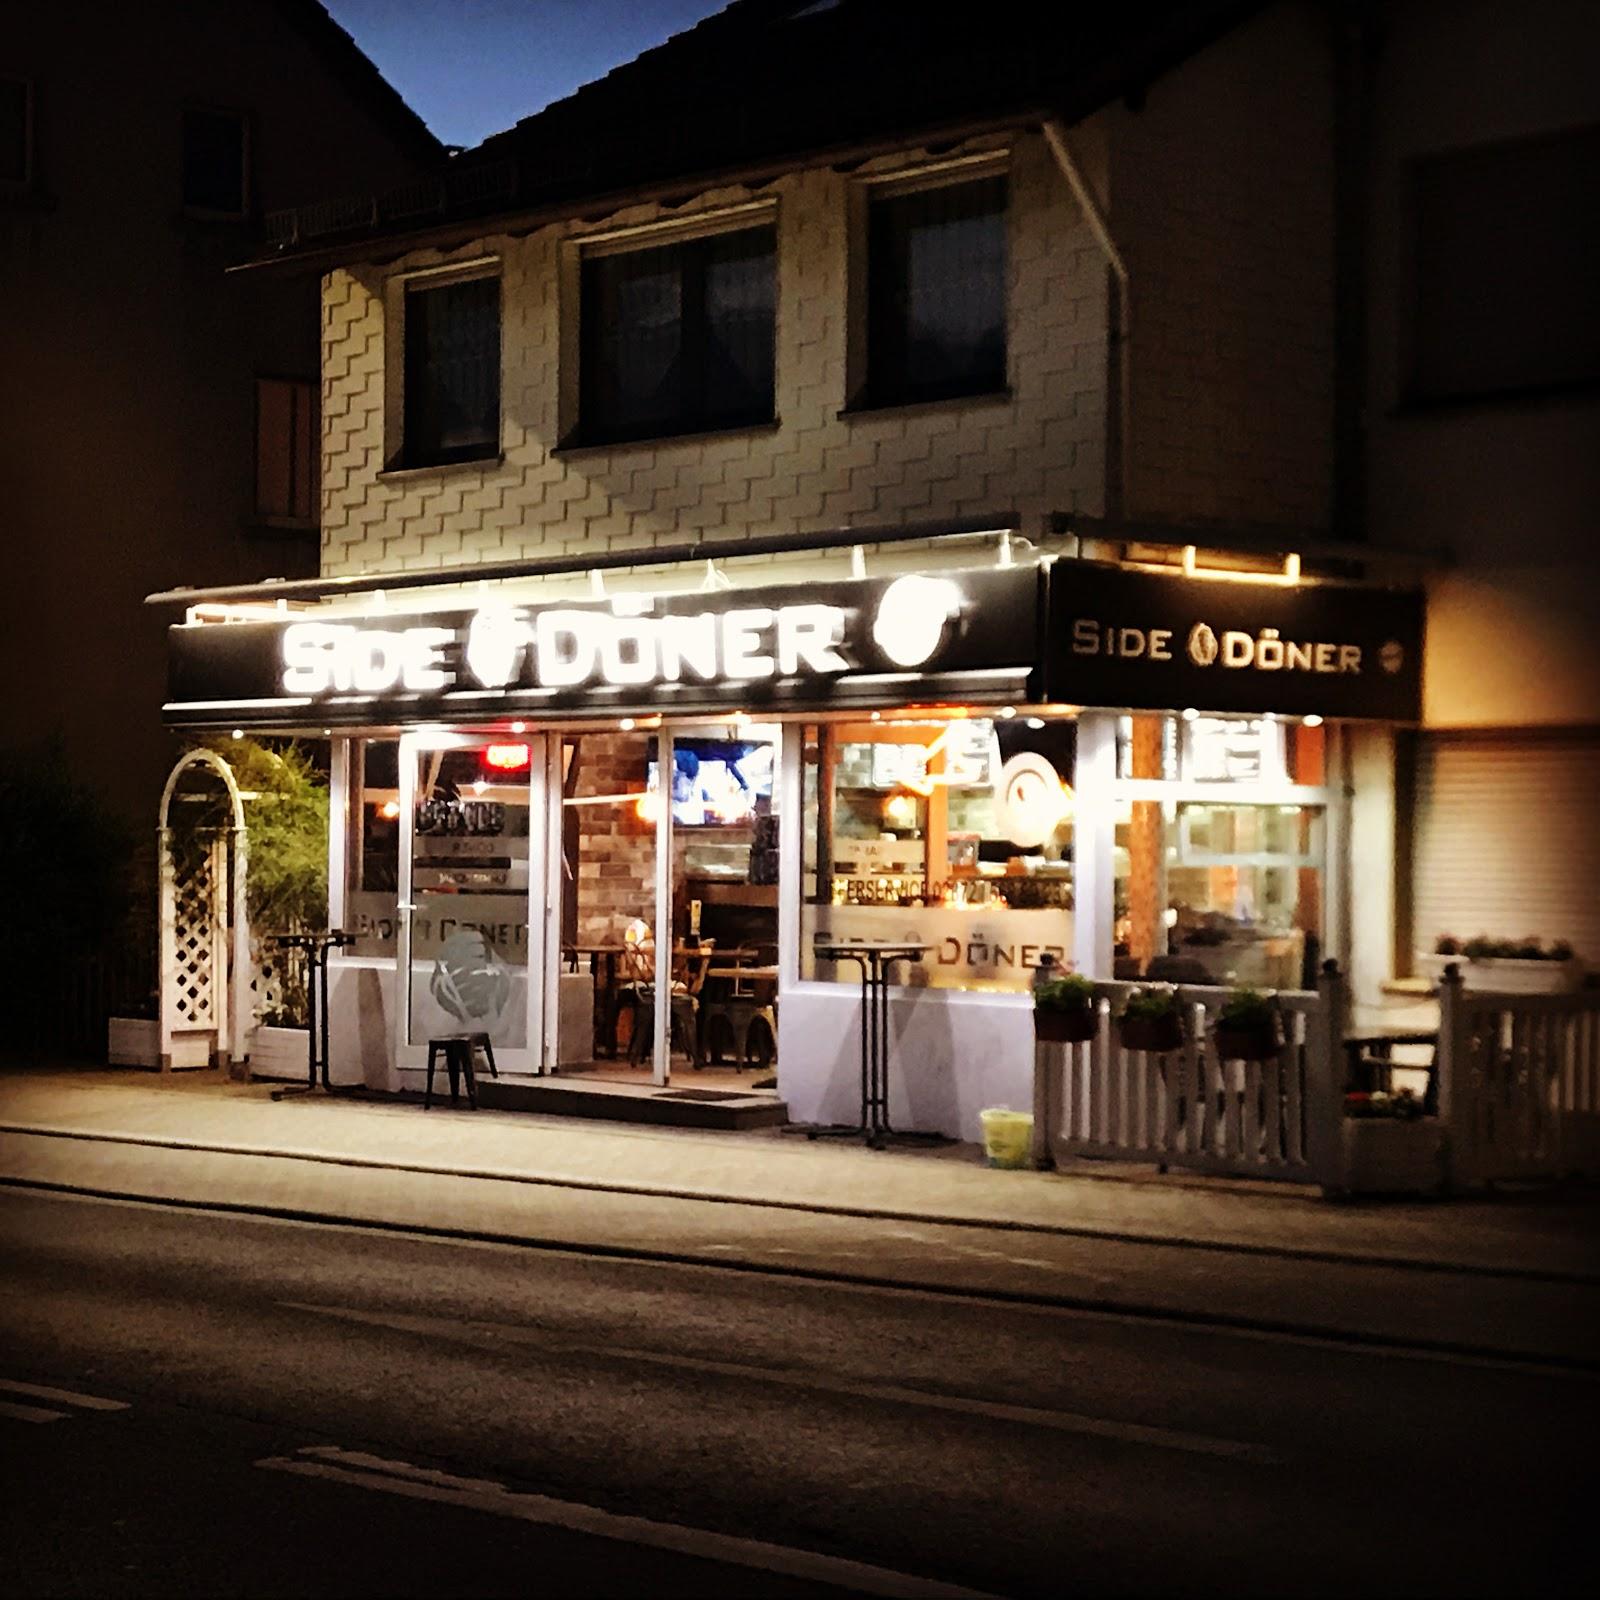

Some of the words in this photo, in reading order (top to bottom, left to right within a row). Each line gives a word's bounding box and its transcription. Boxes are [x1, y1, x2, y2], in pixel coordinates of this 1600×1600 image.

[281, 623, 456, 692] SIDE
[537, 592, 850, 687] DÖNER
[1073, 619, 1172, 660] SIDE
[1222, 628, 1362, 673] DÖNER
